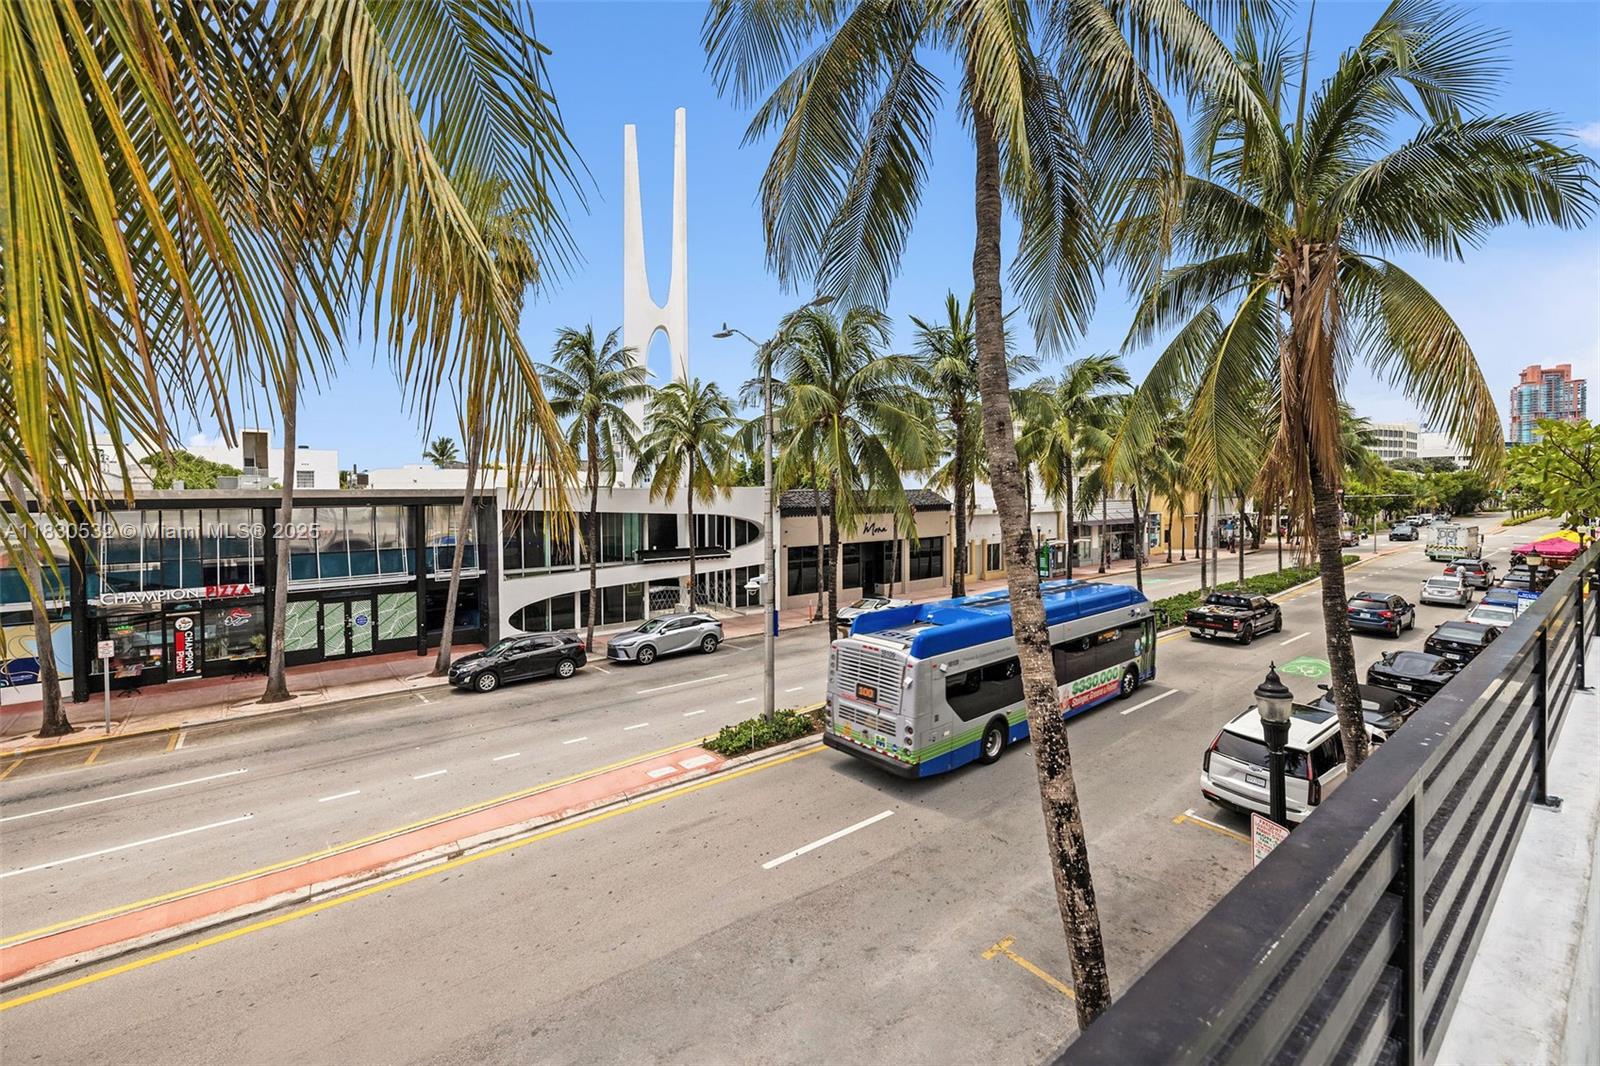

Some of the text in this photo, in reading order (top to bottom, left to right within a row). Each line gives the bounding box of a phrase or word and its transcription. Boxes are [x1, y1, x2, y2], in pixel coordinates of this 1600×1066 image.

[100, 583, 253, 605] CHAMPION PIZZA
[184, 630, 194, 672] CHAMPION
